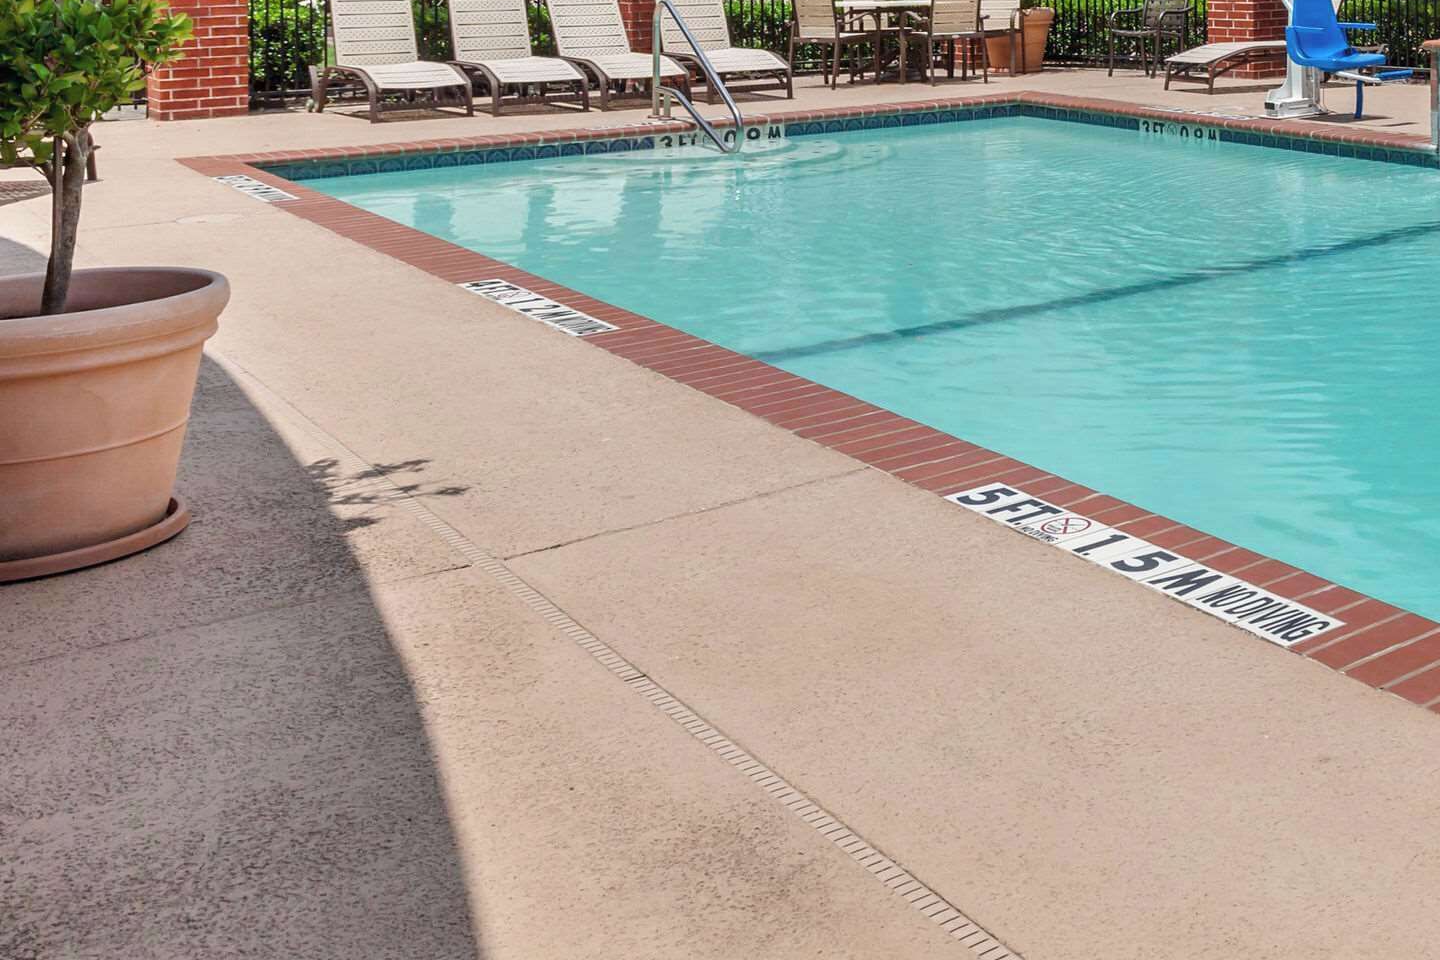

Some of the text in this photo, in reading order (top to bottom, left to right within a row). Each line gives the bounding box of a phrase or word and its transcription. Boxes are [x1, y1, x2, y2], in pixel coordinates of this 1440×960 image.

[956, 487, 1019, 506] 5
[1146, 568, 1222, 597] M
[1196, 585, 1259, 608] NO
[1224, 596, 1331, 642] DIVING
